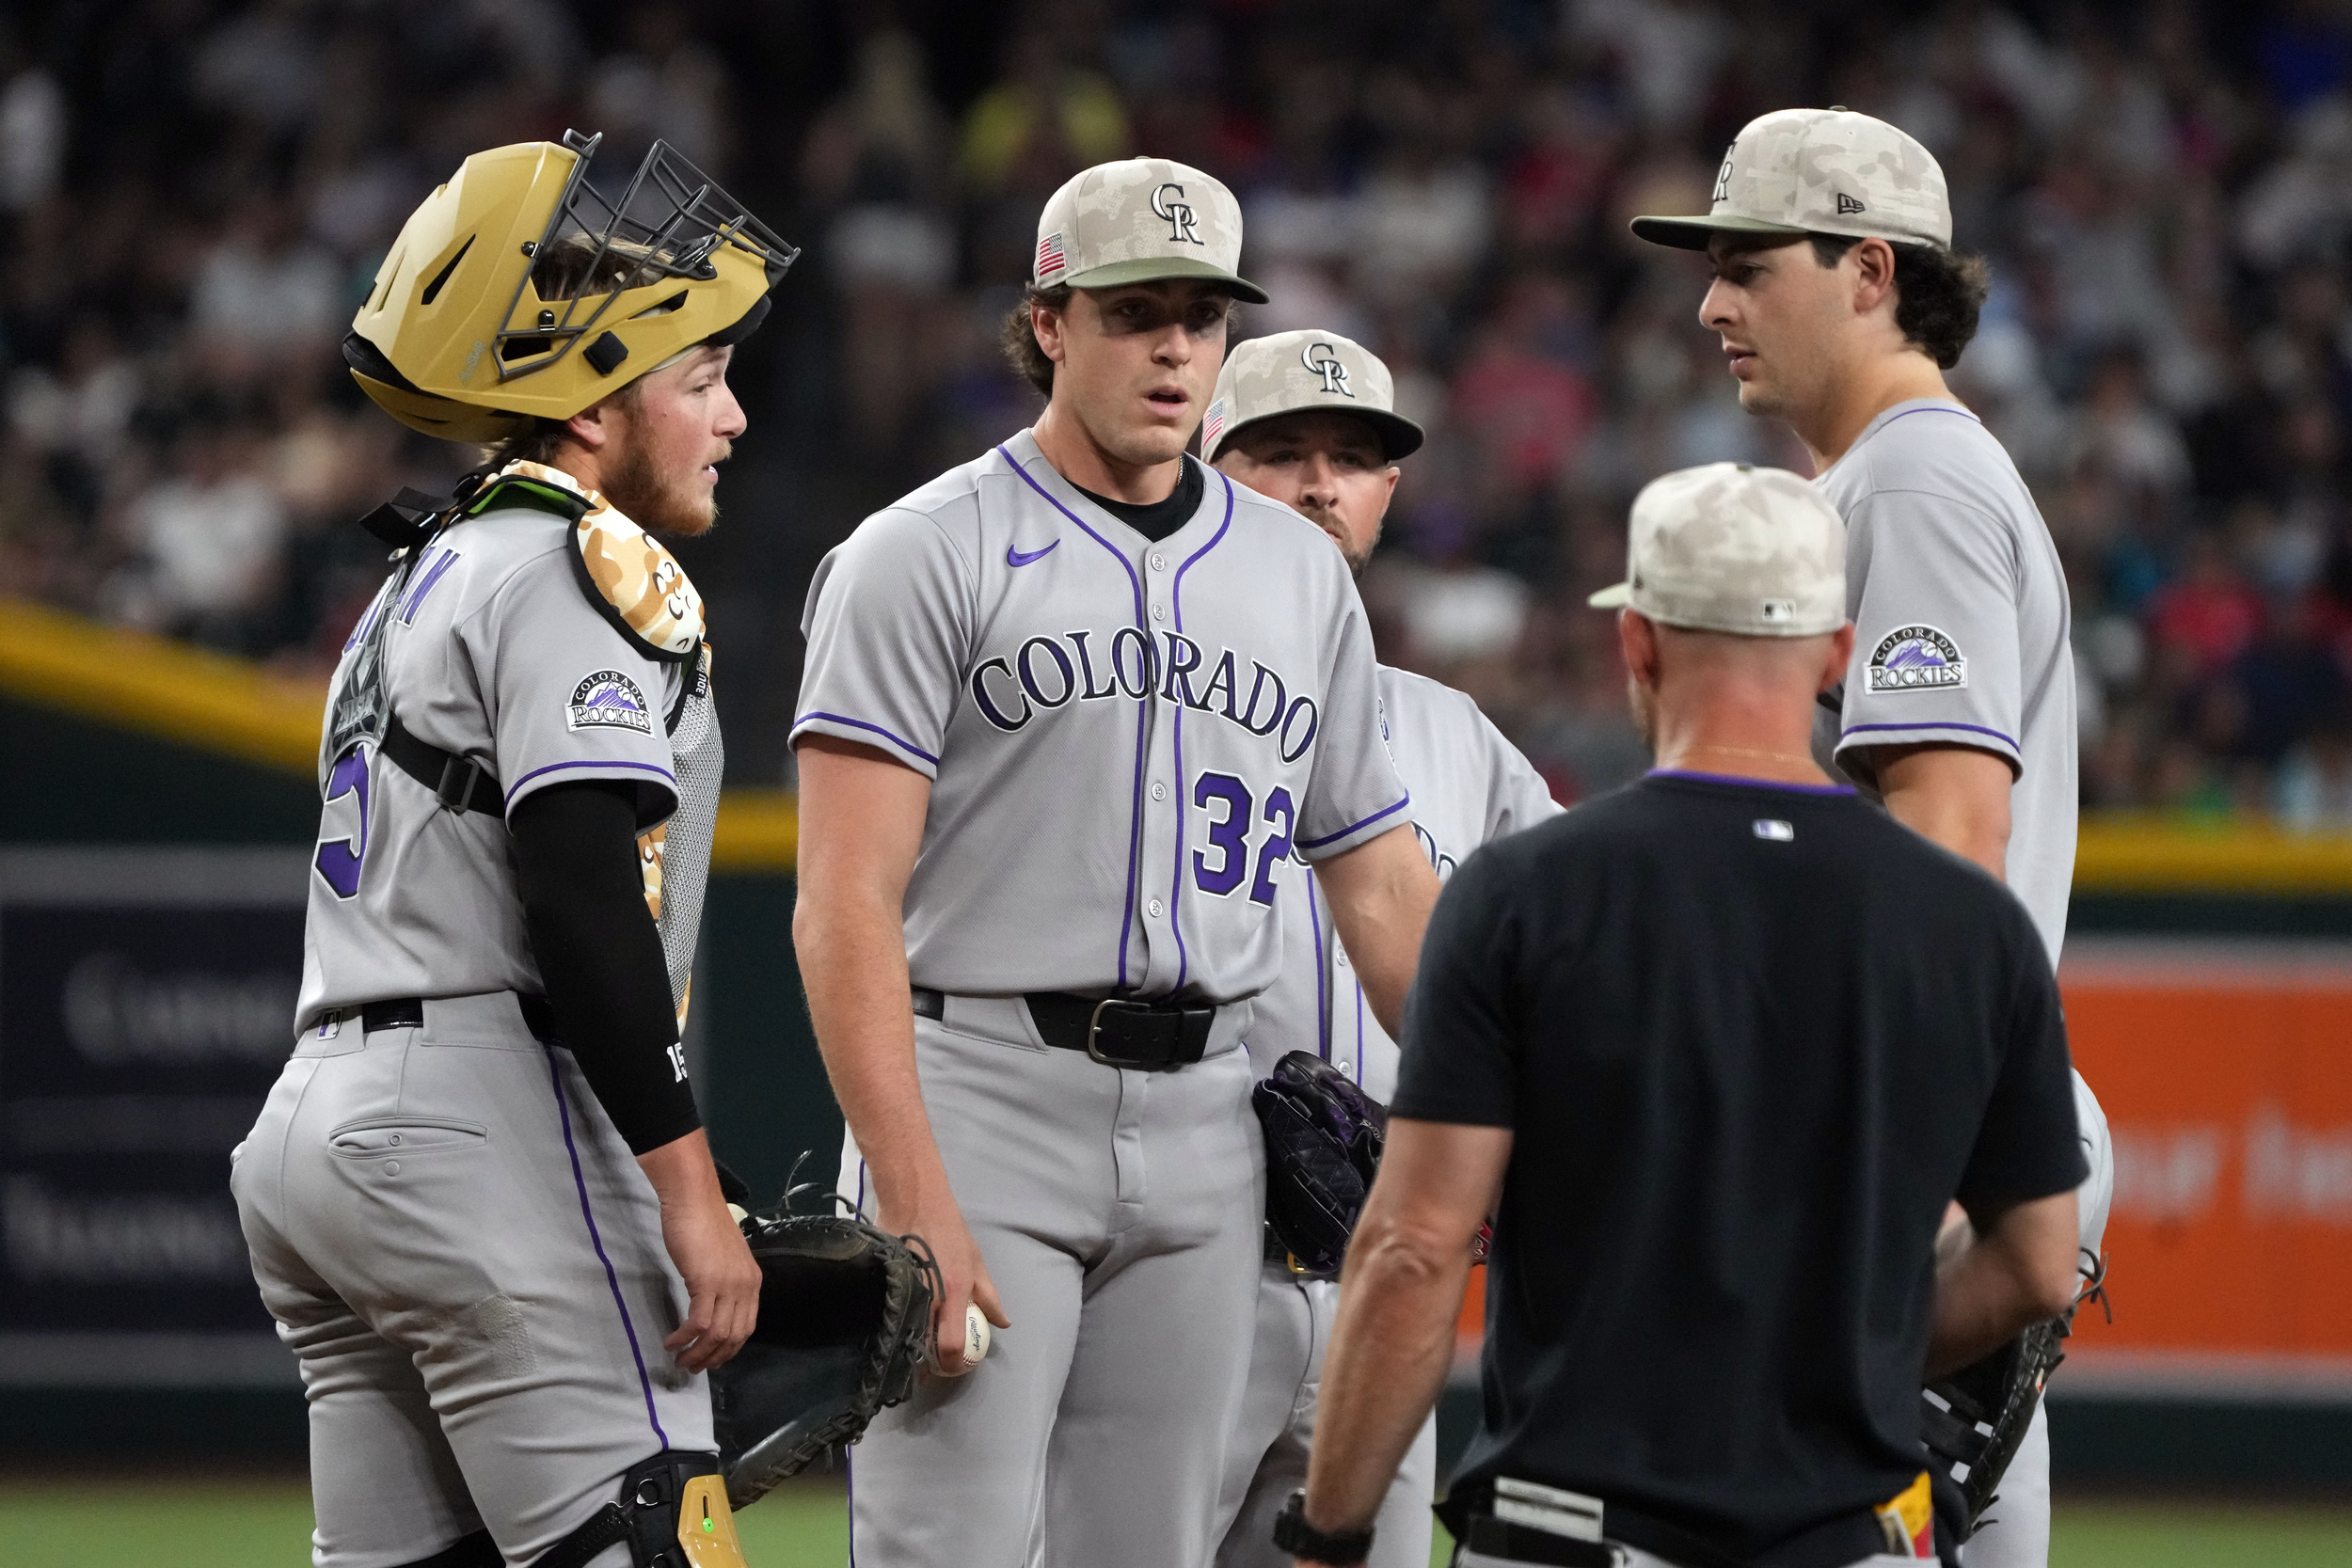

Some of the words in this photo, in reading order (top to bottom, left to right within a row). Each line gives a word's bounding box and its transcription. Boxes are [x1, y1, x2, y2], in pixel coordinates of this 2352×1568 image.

[1876, 627, 1957, 660] COLORADO
[575, 672, 645, 705] COLORADO
[1870, 663, 1963, 687] ROCKIES
[970, 626, 1319, 765] COLORADO
[572, 706, 651, 730] ROCKIES
[1192, 768, 1295, 909] 32
